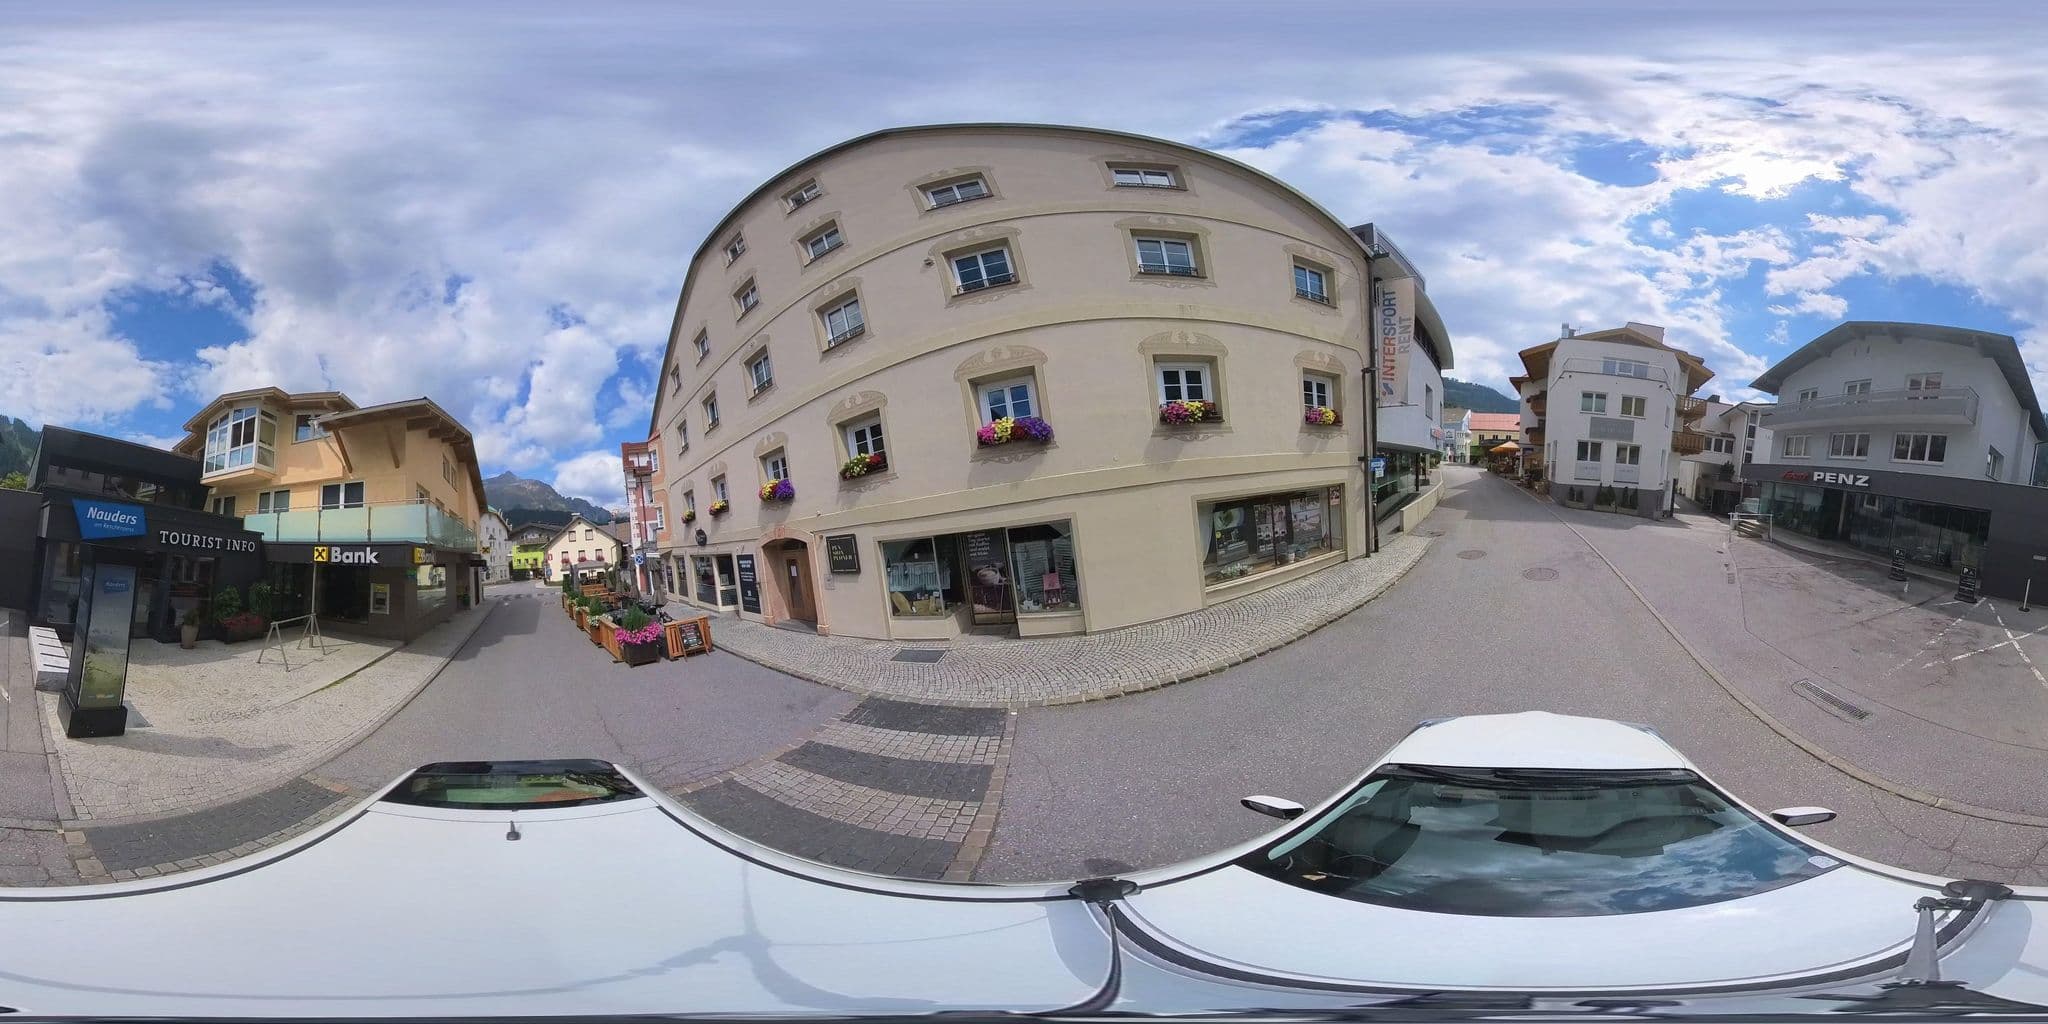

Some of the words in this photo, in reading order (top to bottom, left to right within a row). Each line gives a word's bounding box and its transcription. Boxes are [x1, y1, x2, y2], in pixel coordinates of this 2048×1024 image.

[1382, 290, 1396, 382] INTERSPORT
[1399, 316, 1412, 354] RENT
[1813, 471, 1870, 487] PENZ
[87, 506, 137, 525] Nauders
[159, 530, 223, 549] TOURIST
[227, 538, 256, 552] INFO
[331, 546, 379, 564] Bank
